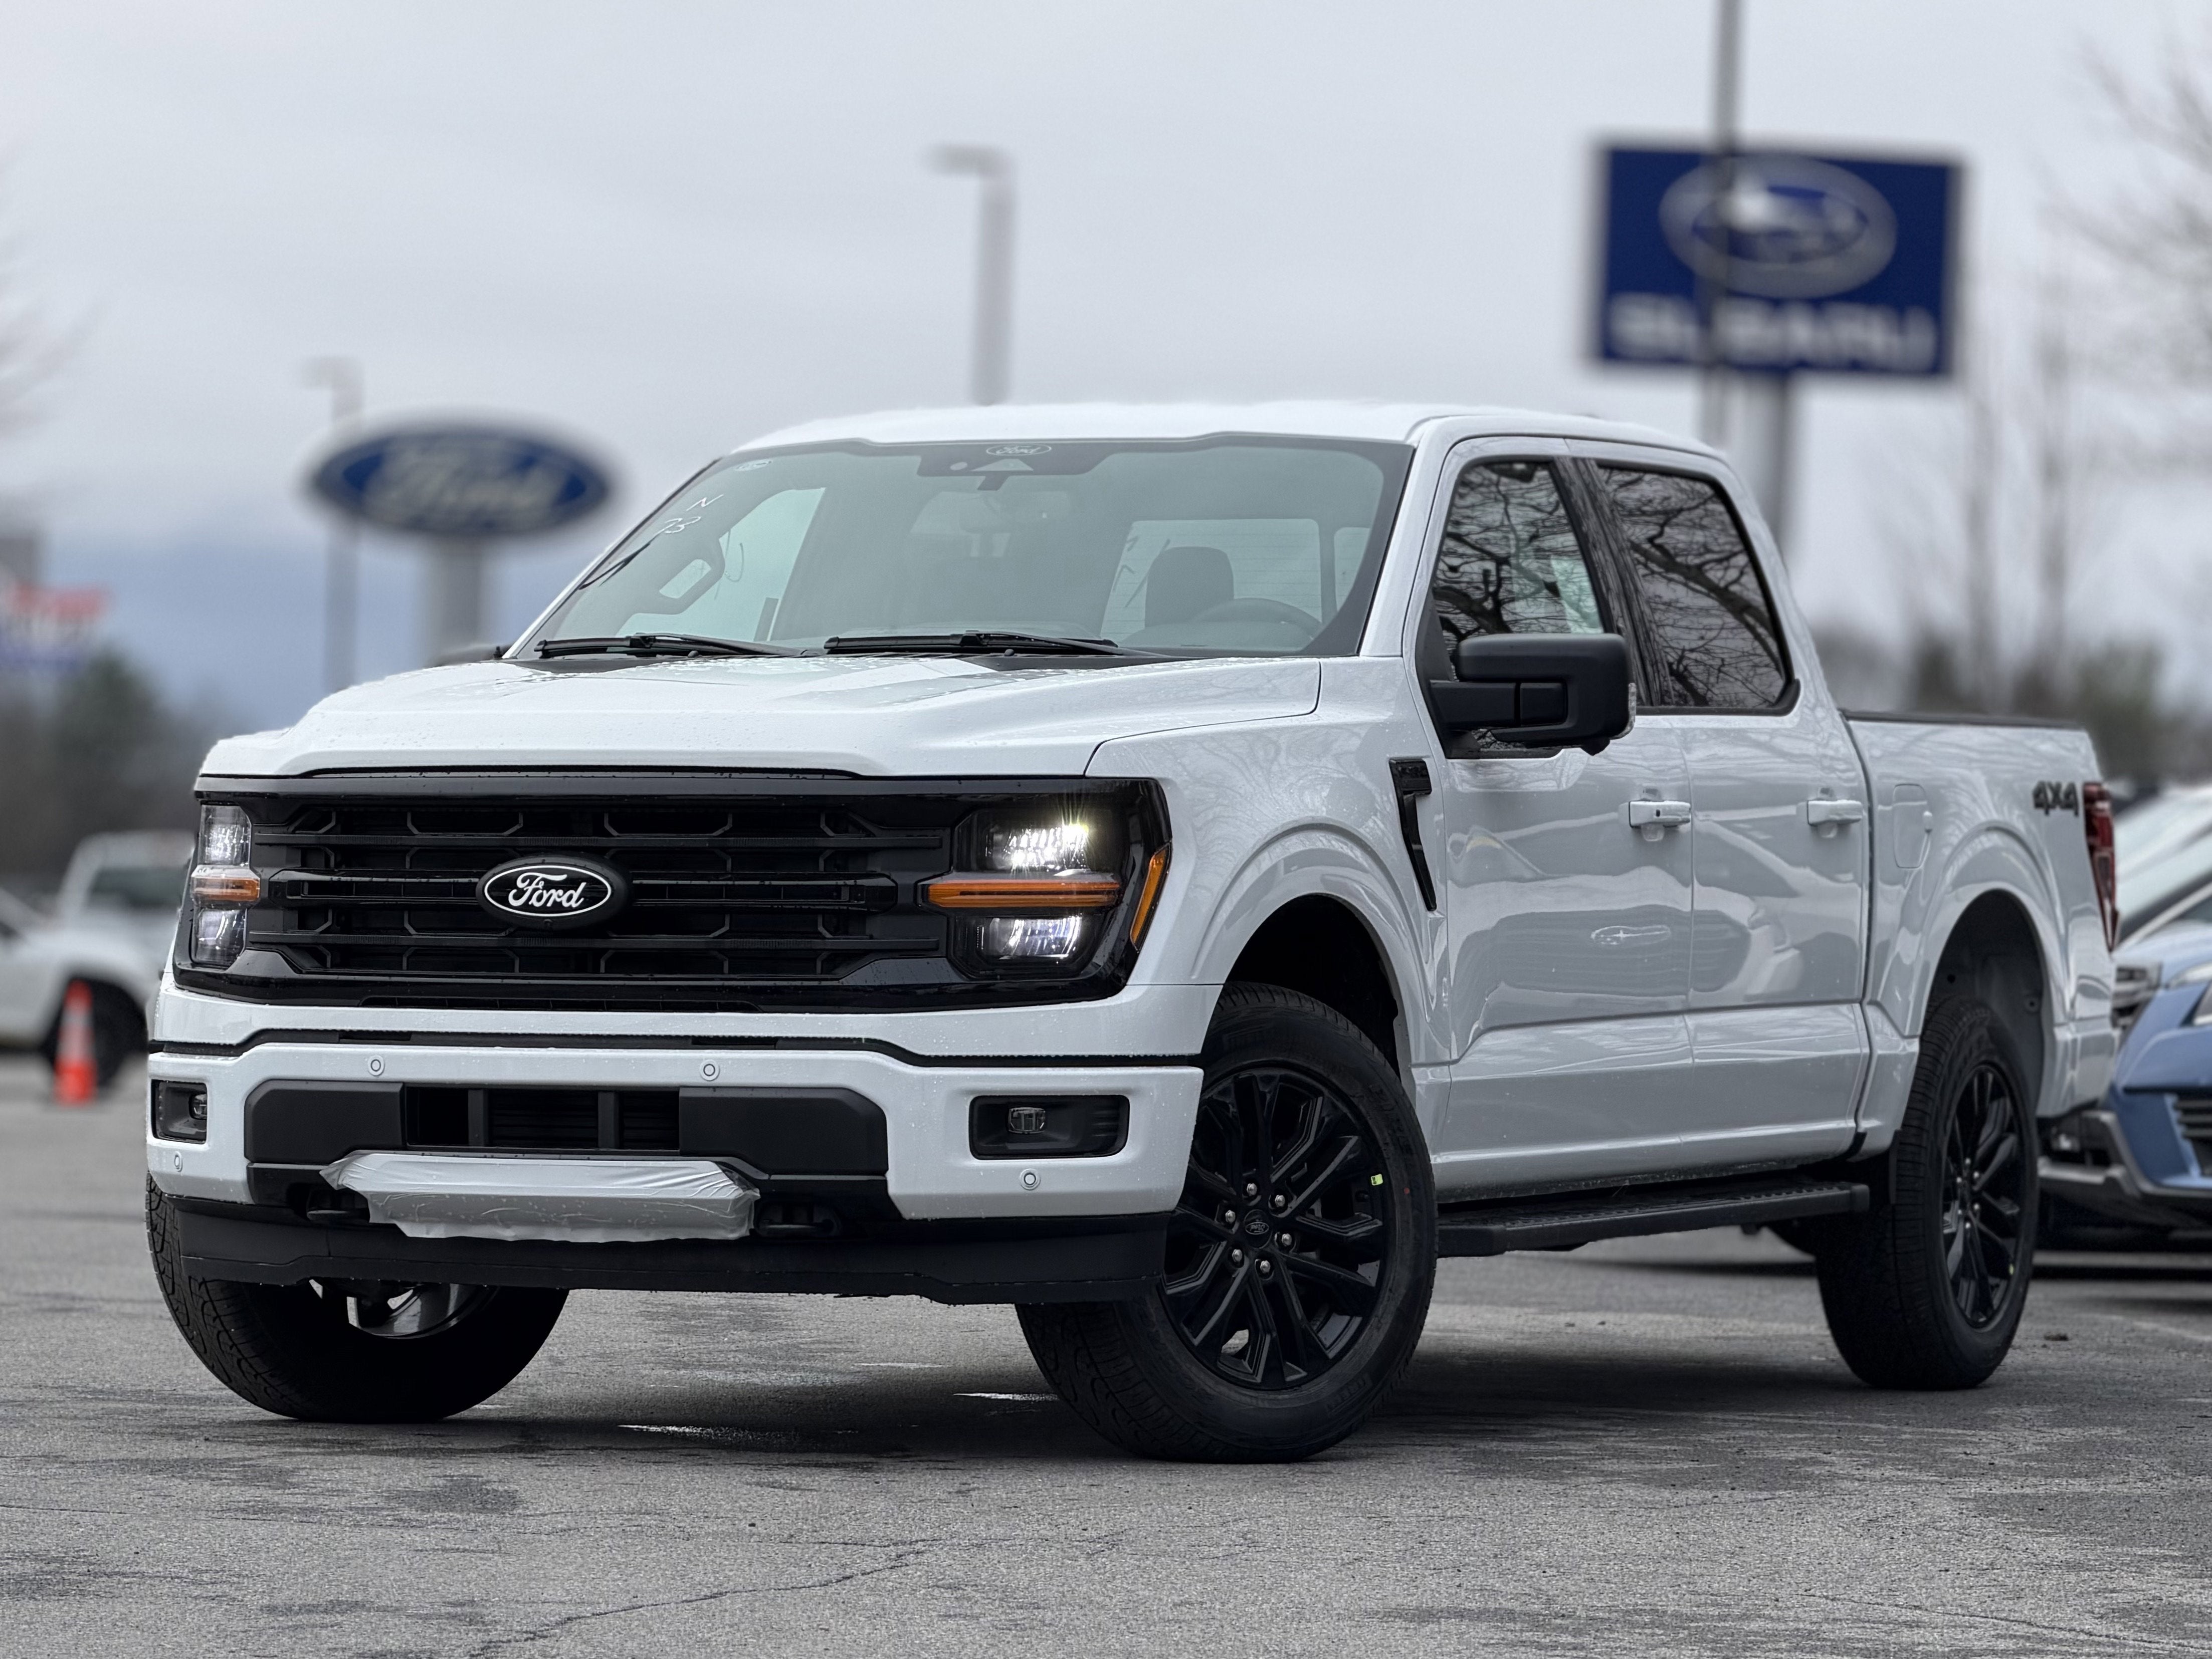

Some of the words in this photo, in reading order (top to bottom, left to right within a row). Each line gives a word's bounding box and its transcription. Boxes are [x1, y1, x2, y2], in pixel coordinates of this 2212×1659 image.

[995, 445, 1041, 454] Ford
[367, 438, 555, 527] Ford
[508, 872, 587, 908] Ford
